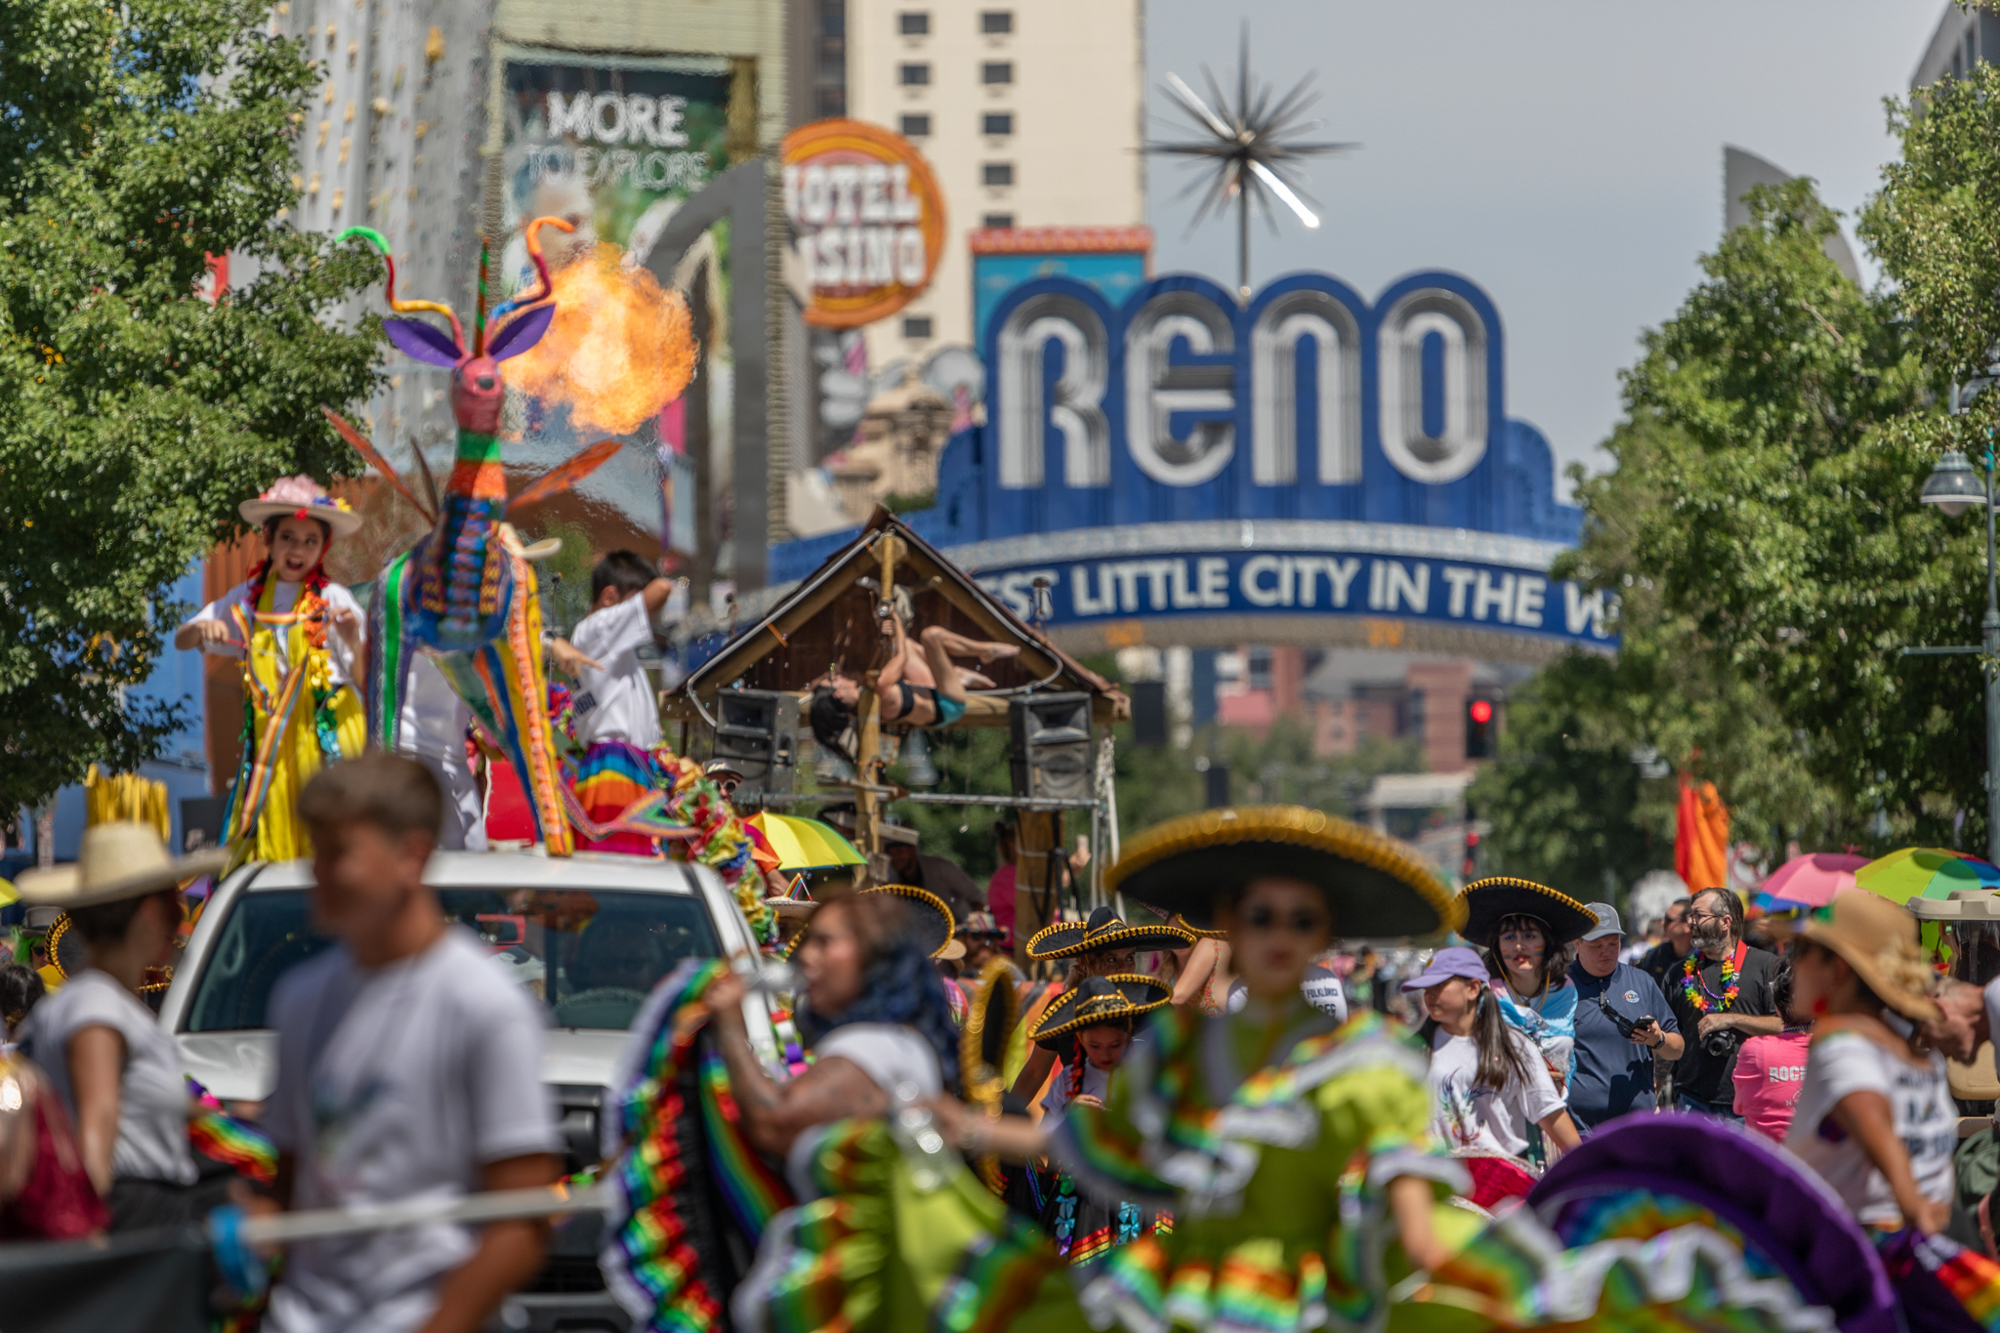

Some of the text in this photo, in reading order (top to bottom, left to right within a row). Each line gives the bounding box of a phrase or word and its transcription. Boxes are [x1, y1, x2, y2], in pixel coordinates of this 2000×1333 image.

[547, 91, 689, 148] MORE
[525, 145, 575, 186] TO
[998, 288, 1489, 488] RENO
[1070, 558, 1230, 616] LITTLE
[1240, 555, 1361, 608] CITY
[1368, 559, 1430, 614] IN
[1442, 566, 1546, 629] THE
